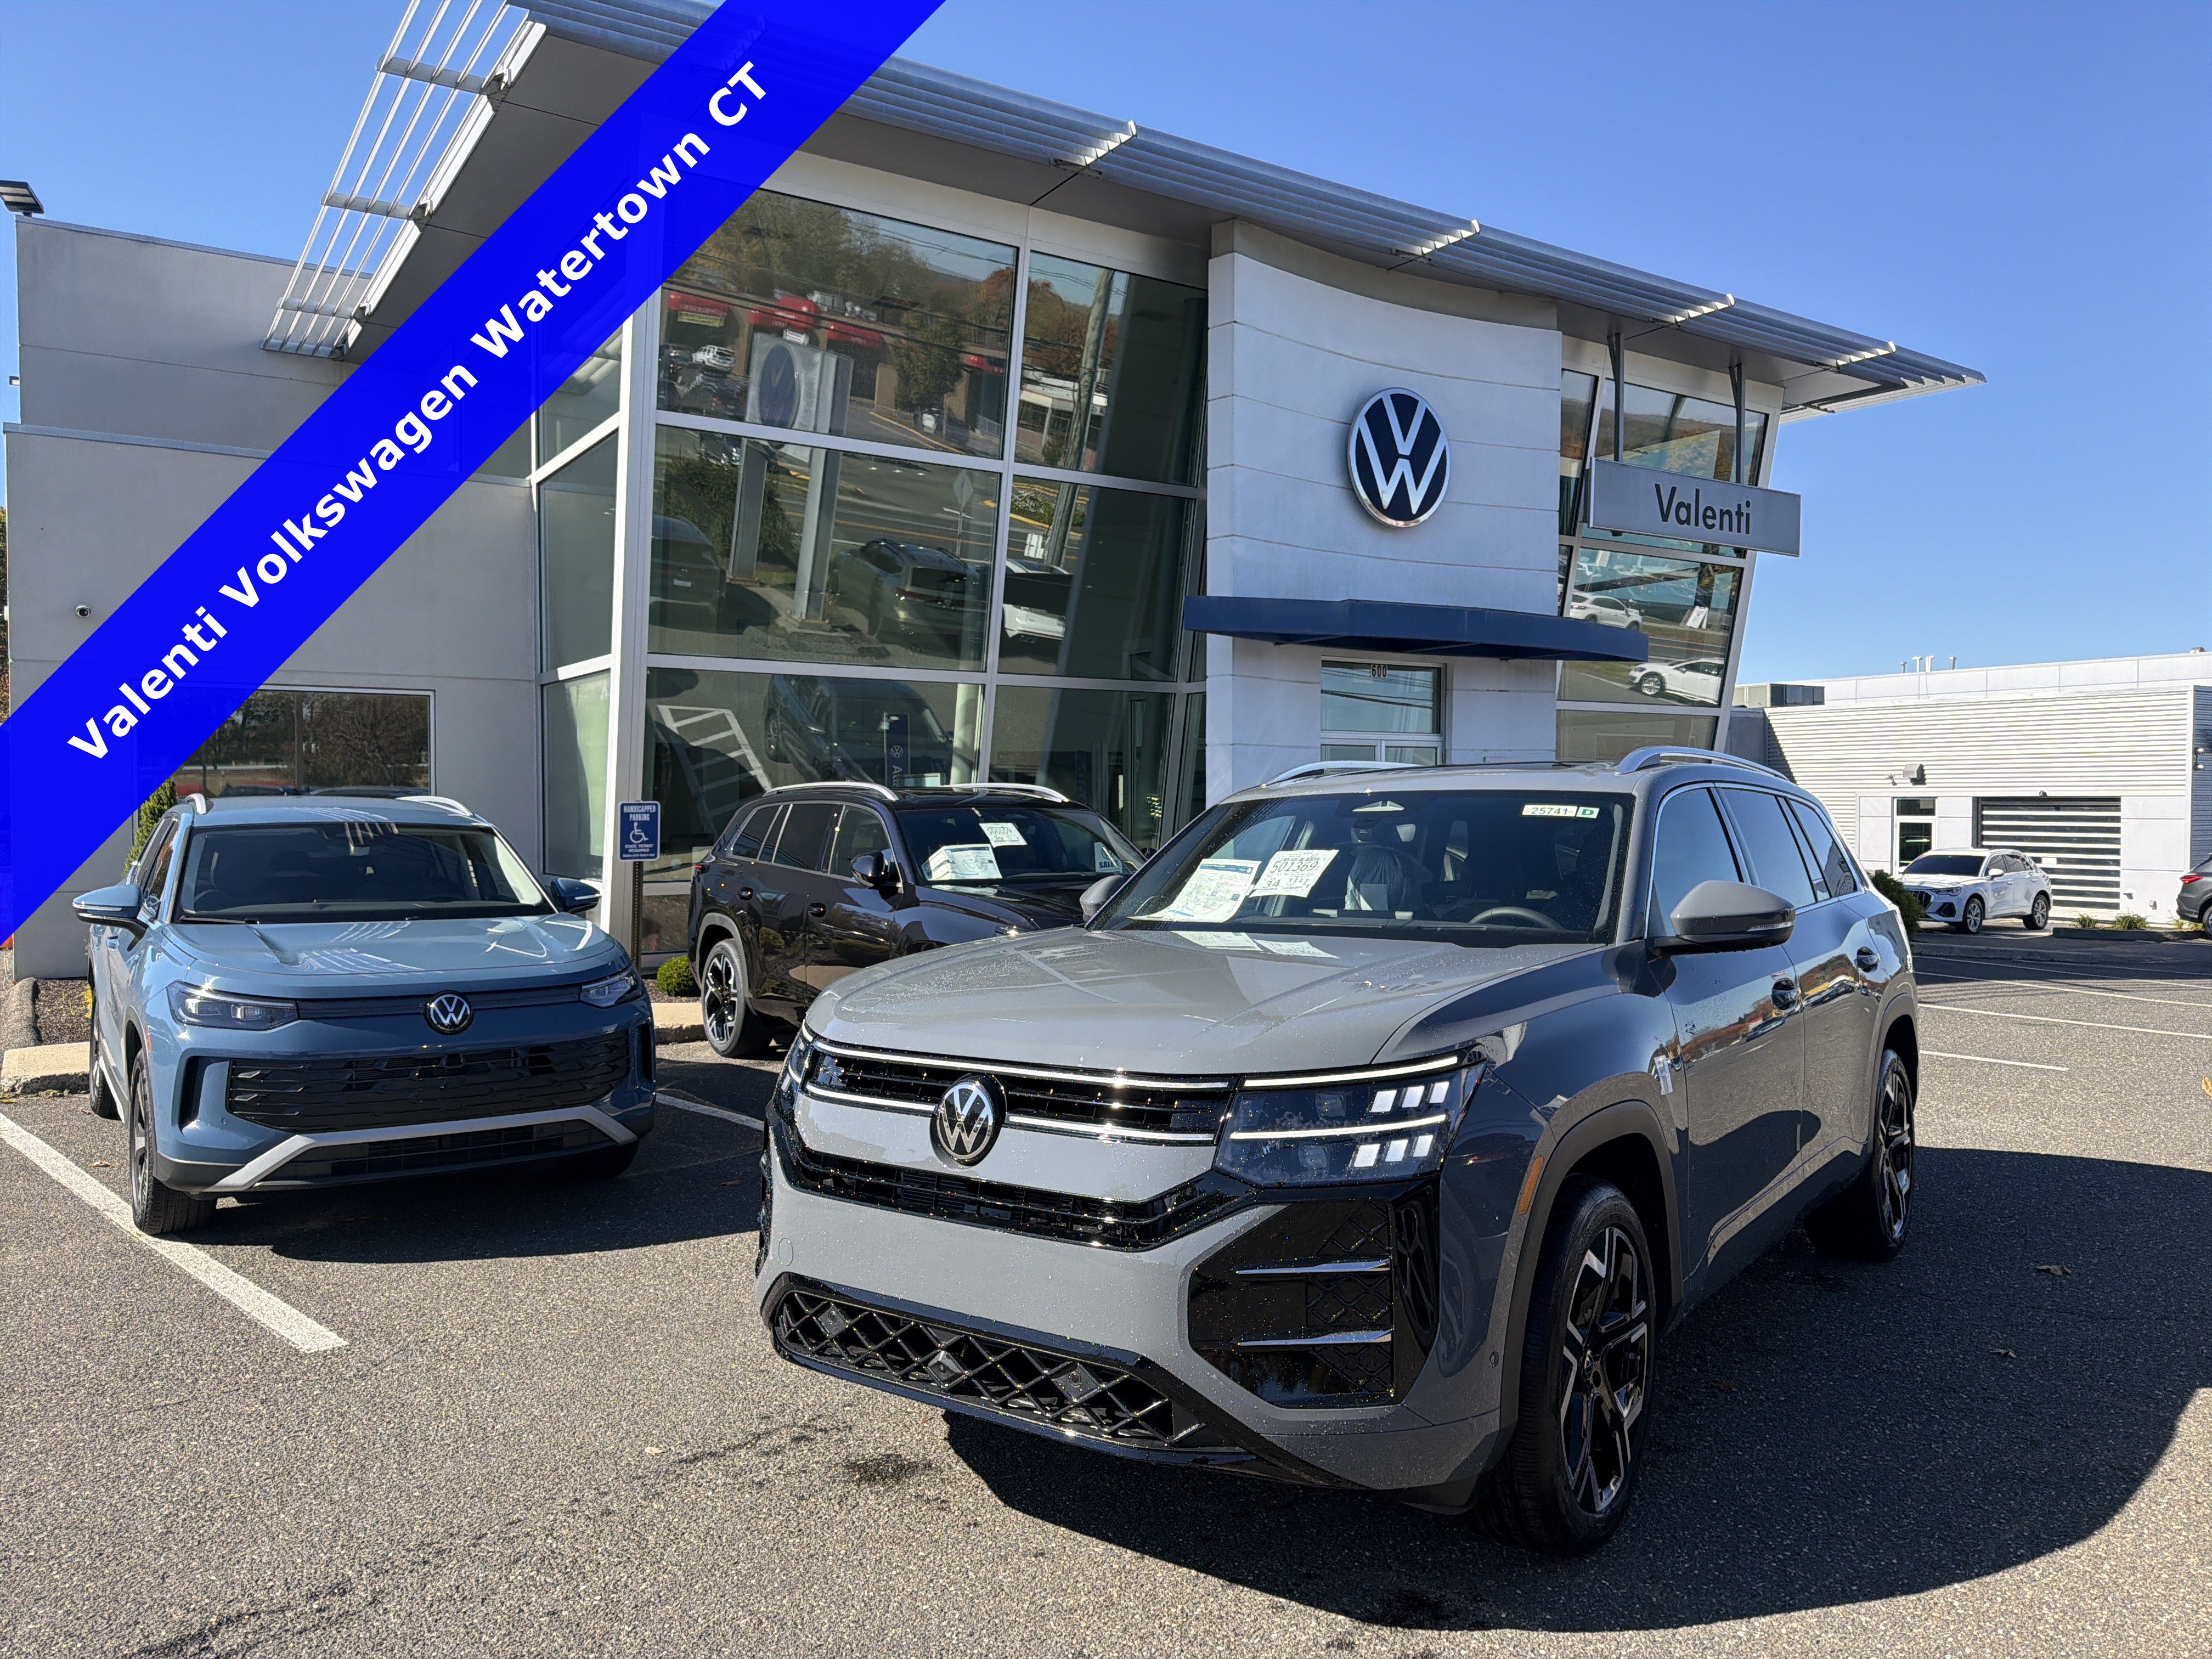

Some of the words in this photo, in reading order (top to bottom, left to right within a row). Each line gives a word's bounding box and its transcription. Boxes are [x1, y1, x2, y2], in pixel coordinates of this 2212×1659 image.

[1655, 483, 1750, 534] Valenti
[1372, 665, 1387, 678] 600
[623, 805, 656, 813] HANDICAPPED
[1531, 807, 1568, 815] 25741
[1270, 861, 1319, 873] 501369
